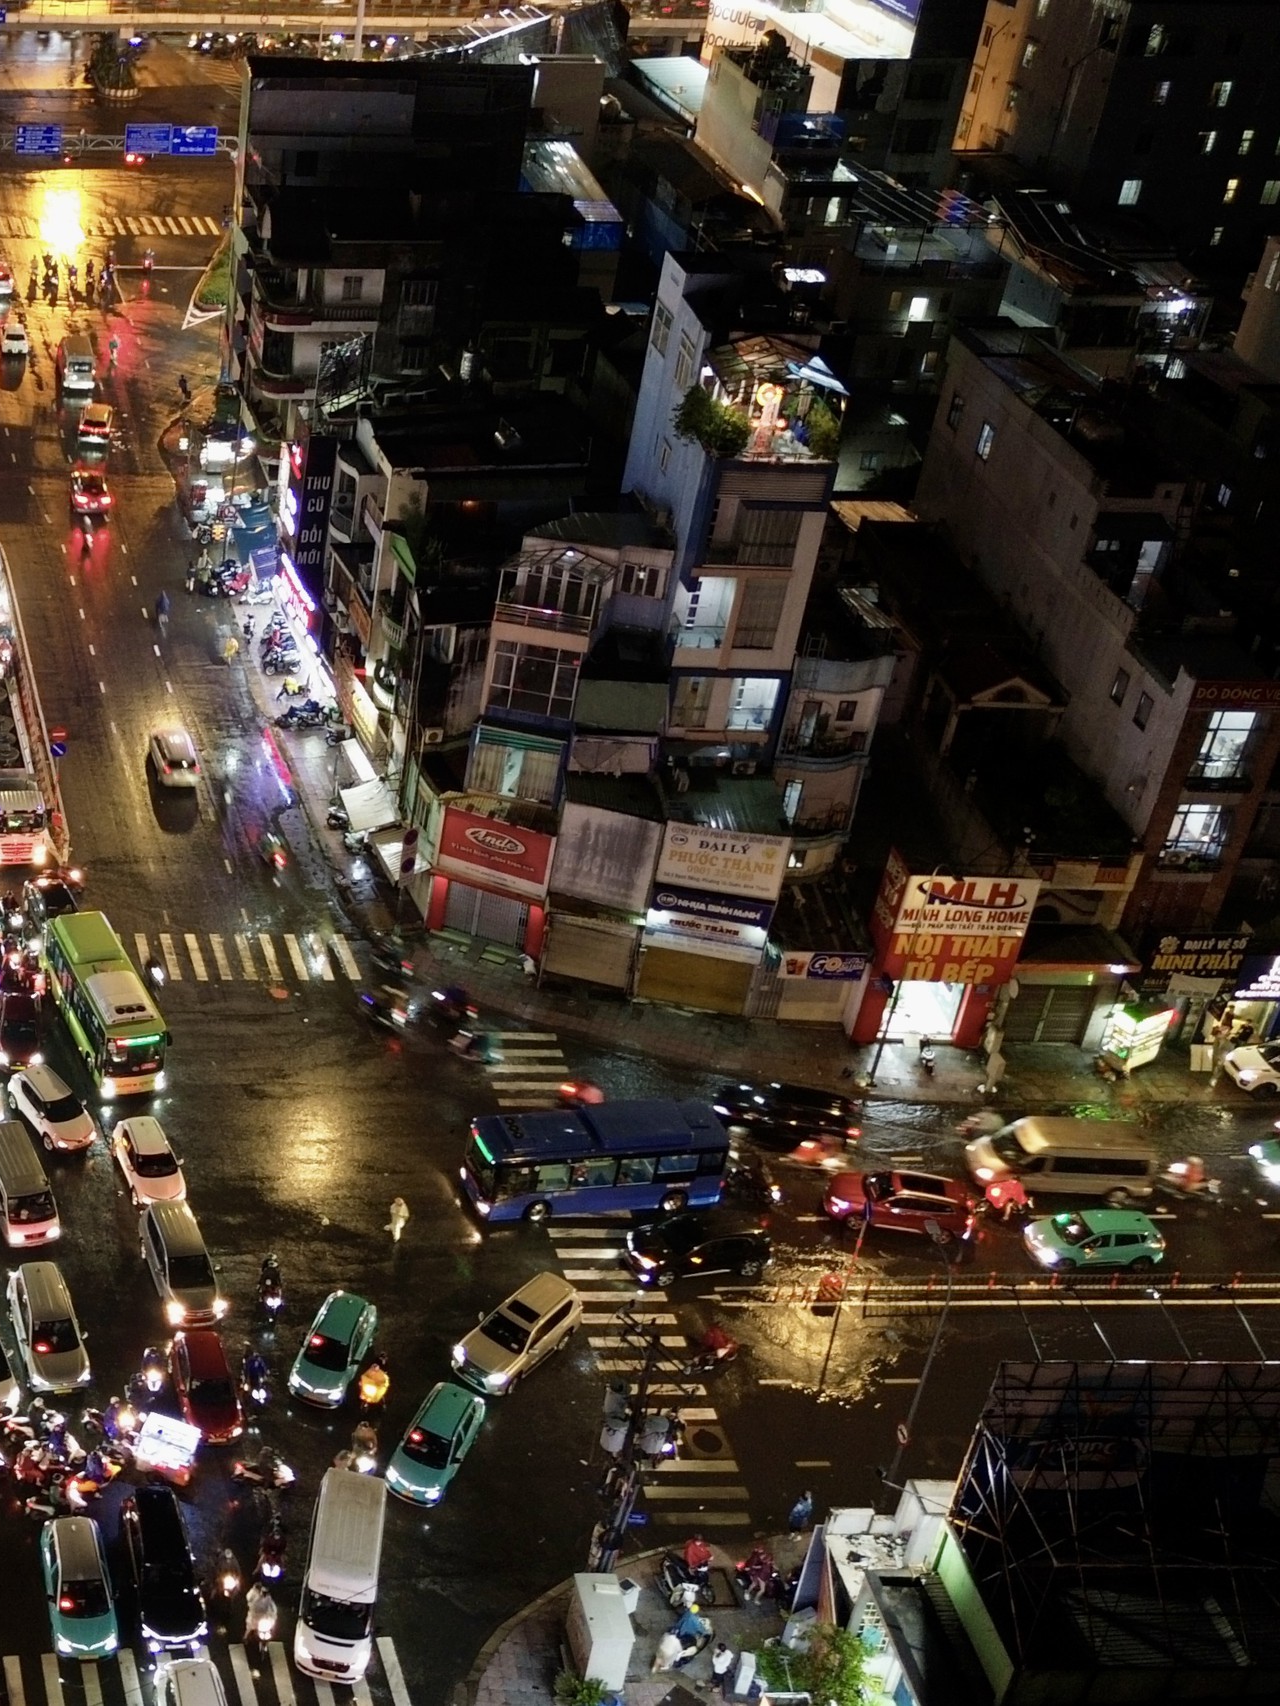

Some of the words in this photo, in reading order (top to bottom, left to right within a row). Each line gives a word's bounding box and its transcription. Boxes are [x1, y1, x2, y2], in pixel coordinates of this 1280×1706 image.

[306, 476, 331, 490] THU
[699, 840, 726, 852] ĐẠI
[731, 843, 751, 854] LÝ
[927, 881, 1019, 906] MLH
[901, 908, 942, 922] MINH
[945, 909, 982, 923] LONG
[986, 910, 1030, 924] HOME
[894, 931, 944, 958] NỘI
[950, 932, 1018, 958] THẤT
[904, 956, 936, 981] TỦ
[941, 959, 995, 984] BẾP
[1151, 954, 1198, 970] MINH
[1196, 951, 1243, 970] PHÁT
